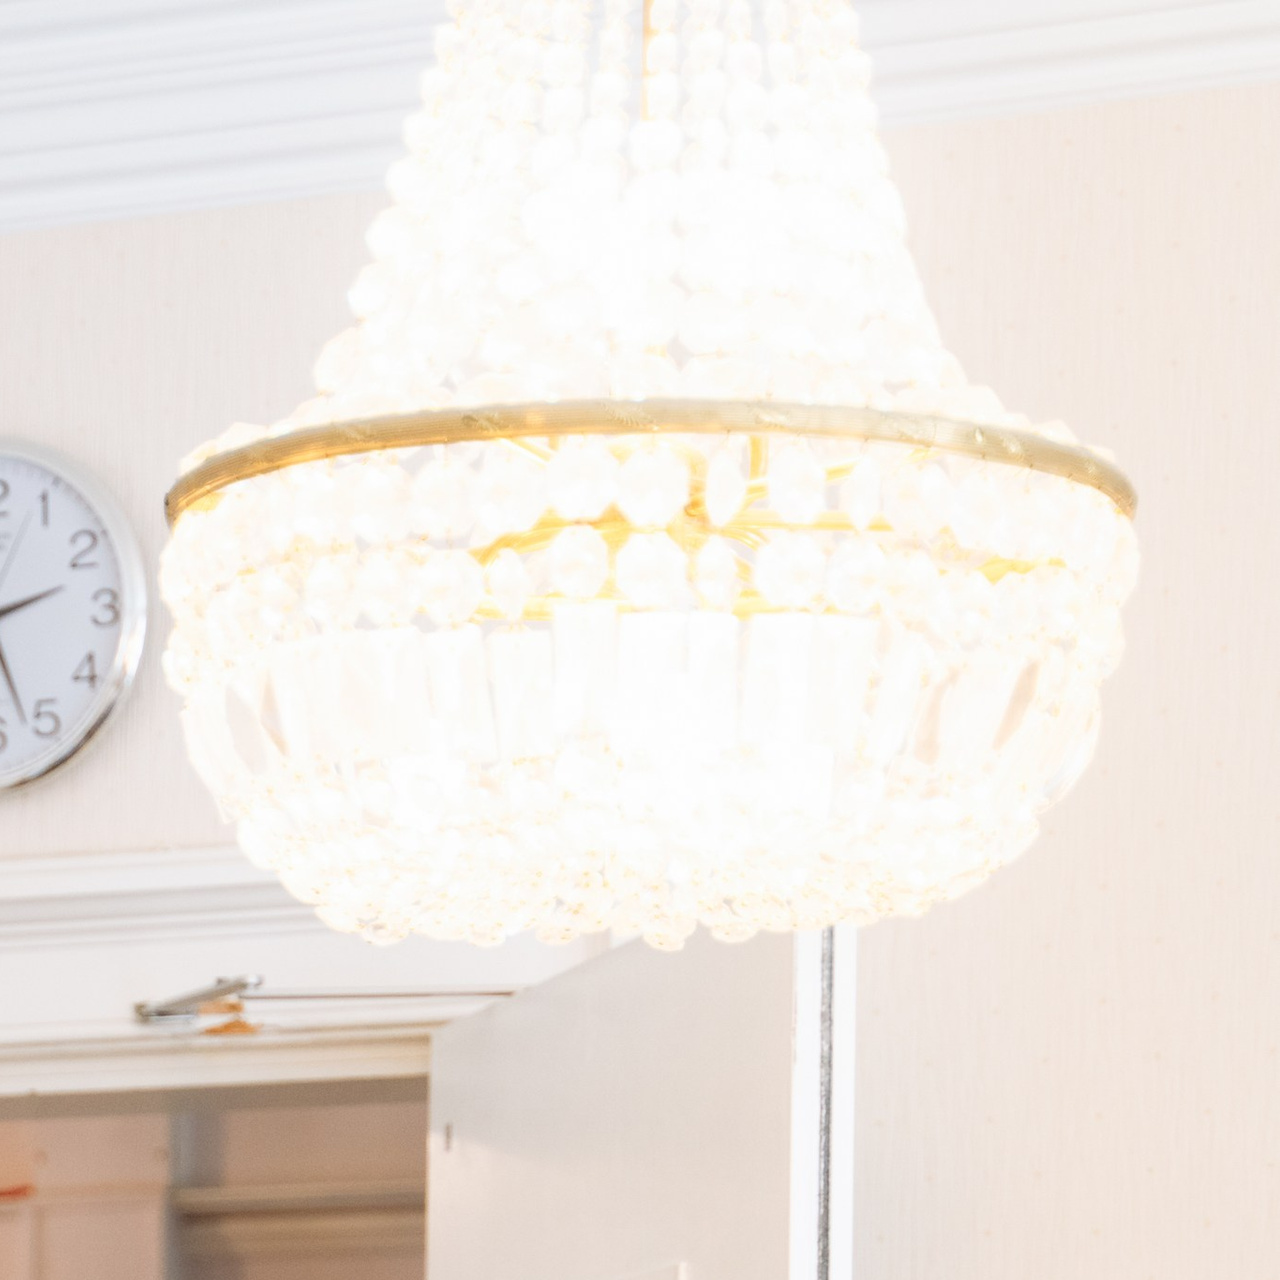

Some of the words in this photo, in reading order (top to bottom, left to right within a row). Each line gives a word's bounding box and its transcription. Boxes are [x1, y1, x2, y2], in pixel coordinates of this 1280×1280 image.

[39, 488, 50, 527] 1
[69, 529, 99, 570] 2
[90, 588, 120, 627] 3
[72, 652, 97, 689] 4
[34, 699, 60, 737] 5
